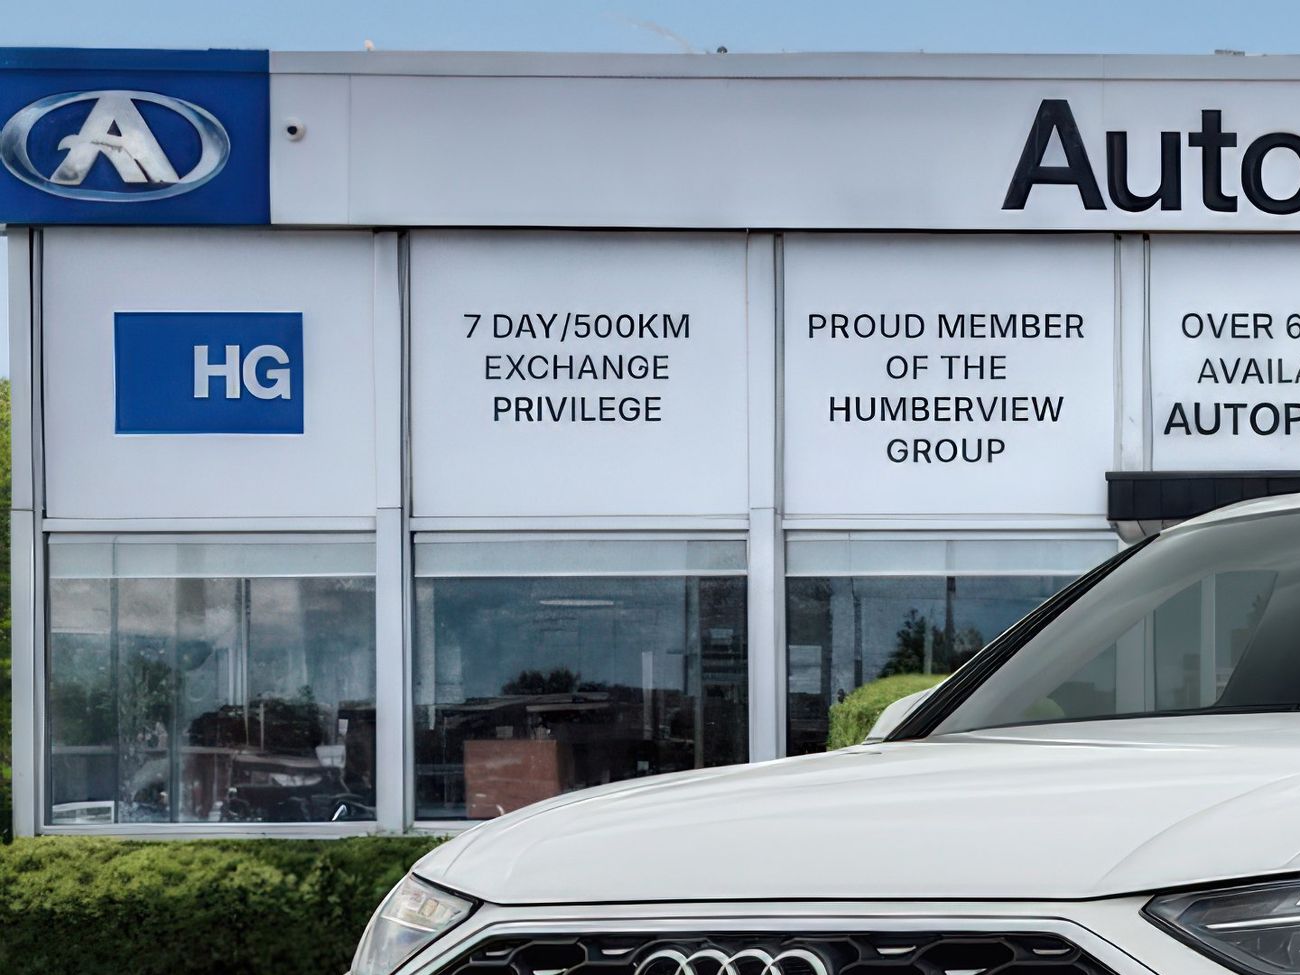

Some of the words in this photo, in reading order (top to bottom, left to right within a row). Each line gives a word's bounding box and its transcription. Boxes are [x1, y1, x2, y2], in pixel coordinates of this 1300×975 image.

[464, 314, 482, 339] 7
[493, 313, 690, 343] DAY/500KM
[808, 313, 925, 339] PROUD
[938, 313, 1085, 339] MEMBER
[1181, 312, 1274, 340] OVER
[193, 345, 291, 400] HG
[485, 354, 670, 381] EXCHANGE
[886, 354, 929, 380] OF
[940, 354, 1007, 380] THE
[493, 396, 662, 423] PRIVILEGE
[829, 396, 1065, 423] HUMBERVIEW
[886, 438, 1006, 464] GROUP
